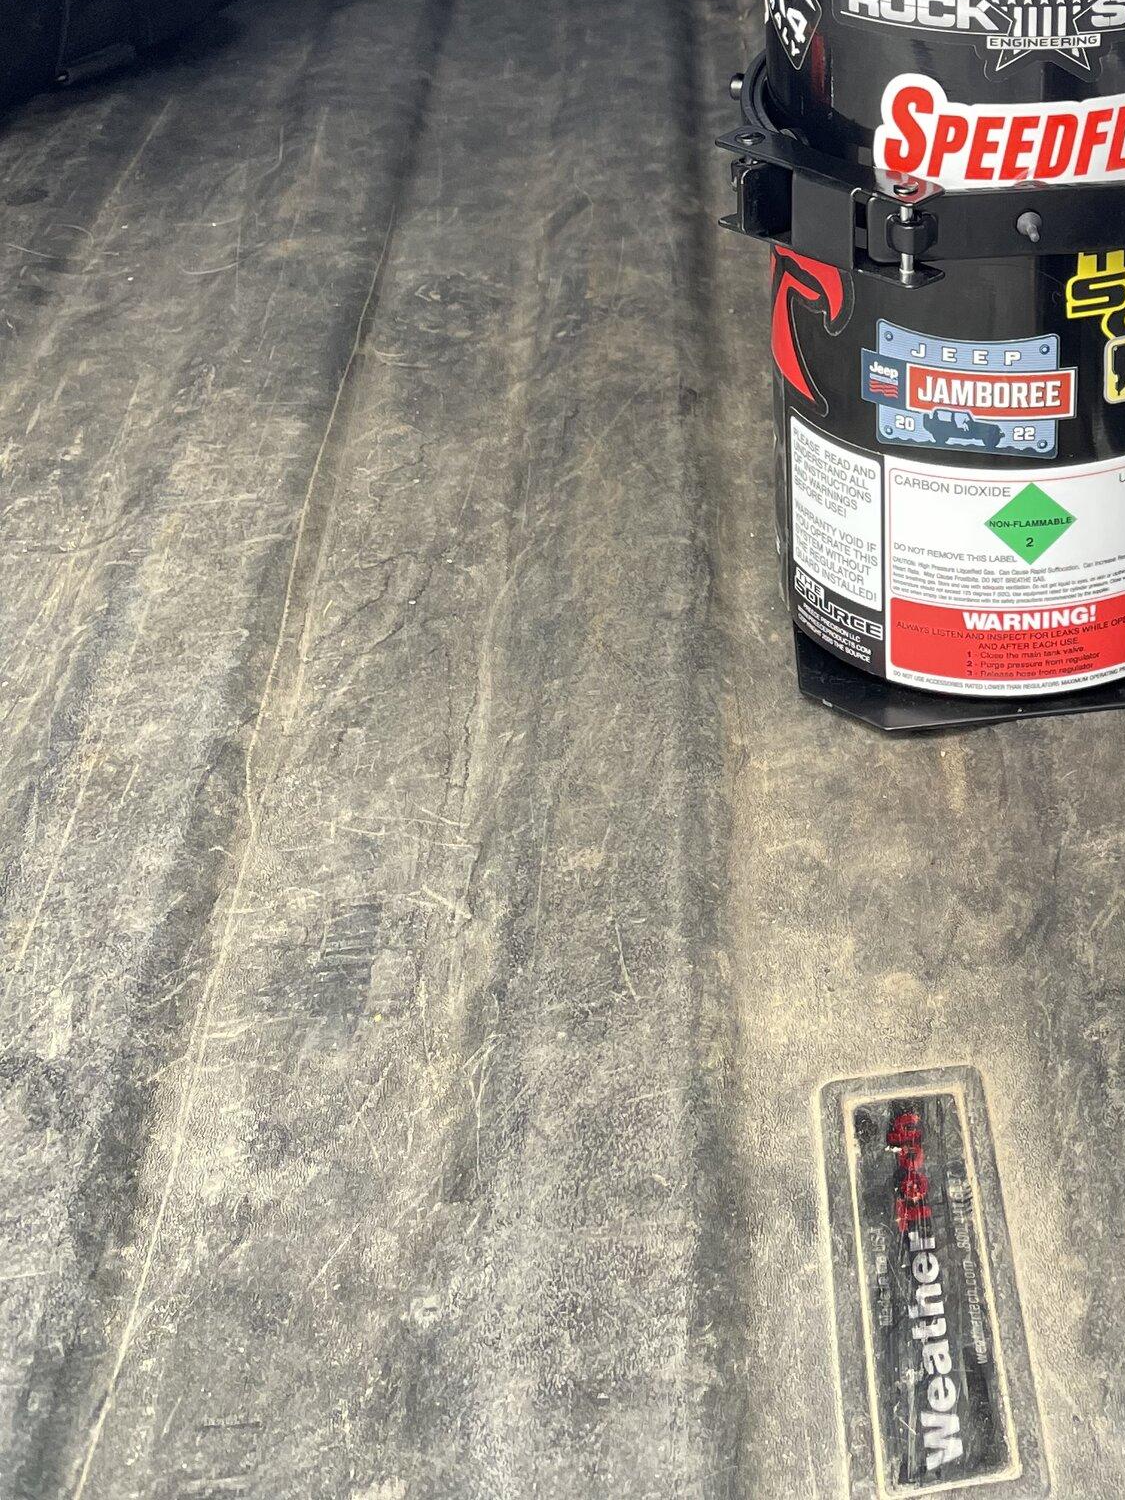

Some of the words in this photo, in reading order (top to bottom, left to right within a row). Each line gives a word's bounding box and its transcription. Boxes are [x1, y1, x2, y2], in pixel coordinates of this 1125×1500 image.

[988, 35, 1099, 49] ENGINEERING
[910, 343, 1022, 367] JEEP
[868, 361, 899, 380] Jeep
[917, 375, 1062, 409] JAMBOREE
[894, 414, 915, 431] 20
[1012, 426, 1036, 442] 22
[793, 427, 821, 456] PLEASE
[824, 450, 851, 471] READ
[853, 464, 877, 480] AND
[794, 440, 848, 482] UNDERSTAND
[849, 475, 870, 491] ALL
[803, 461, 873, 504] INSTRUCTIONS
[809, 476, 858, 511] WARNINGS
[894, 474, 950, 494] CARBON
[953, 483, 1012, 498] DIOXIDE
[795, 499, 838, 537] WARRANTY
[839, 530, 864, 549] VOID
[866, 541, 877, 553] IF
[989, 516, 1073, 528] NON-FLAMMABLE
[810, 525, 851, 556] OPERATE
[853, 549, 878, 567] THIS
[893, 542, 907, 552] DO
[907, 545, 926, 556] NOT
[927, 549, 965, 562] REMOVE
[966, 553, 988, 563] THIS
[988, 555, 1018, 563] LABEL
[1026, 537, 1034, 548] 2
[809, 548, 864, 586] REGULATOR
[825, 546, 872, 576] WITHOUT
[796, 567, 824, 598] THE
[795, 575, 884, 642] SOURCE
[962, 604, 1097, 632] WARNING!
[896, 621, 930, 635] ALWAYS
[931, 627, 964, 639] LISTEN
[964, 632, 985, 641] AND
[986, 633, 1027, 641] INSPECT
[1029, 631, 1049, 640] FOR
[1050, 627, 1080, 639] LEAKS
[1082, 621, 1109, 633] WHILE
[978, 642, 999, 650] AND
[1032, 640, 1058, 649] EACH
[1059, 637, 1079, 647] USE
[980, 652, 1004, 660] Close
[1006, 651, 1020, 659] the
[1021, 650, 1042, 658] main
[1043, 649, 1061, 657] tank
[980, 661, 1005, 669] Purge
[1045, 658, 1064, 667] from
[1038, 667, 1057, 676] from
